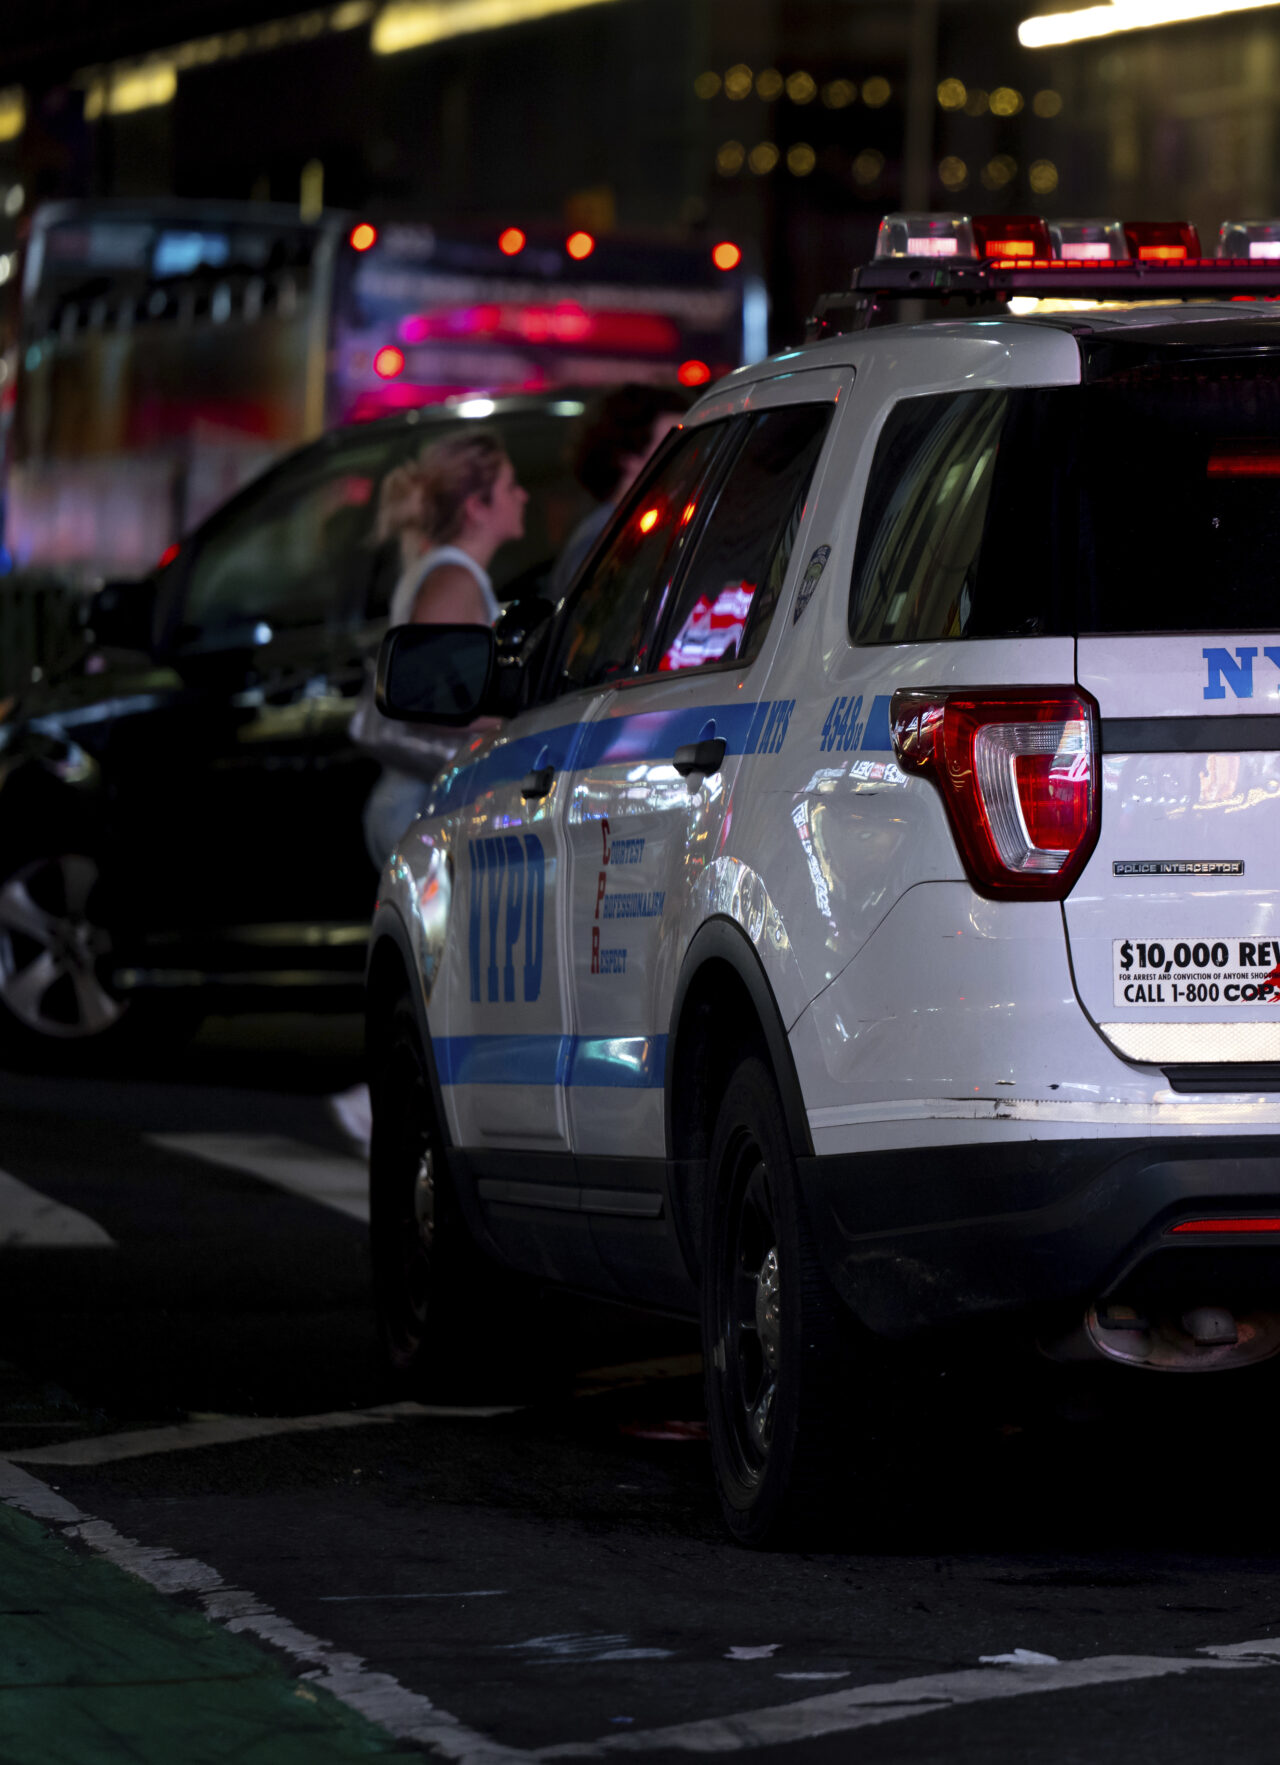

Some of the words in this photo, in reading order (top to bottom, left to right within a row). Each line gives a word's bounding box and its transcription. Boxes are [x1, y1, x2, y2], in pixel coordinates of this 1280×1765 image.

[1116, 864, 1157, 873] POLICE
[1160, 864, 1239, 873] INTERCEPTOR
[468, 833, 545, 1003] NYPD
[1120, 940, 1229, 972] $10,000
[1119, 973, 1132, 981] FOR
[1133, 973, 1157, 981] ARREST
[1173, 972, 1209, 980] CONVICTION
[1210, 972, 1222, 980] OF
[1223, 972, 1249, 980] ANYONE
[1124, 983, 1165, 1003] CALL
[1171, 983, 1220, 1003] 1-800
